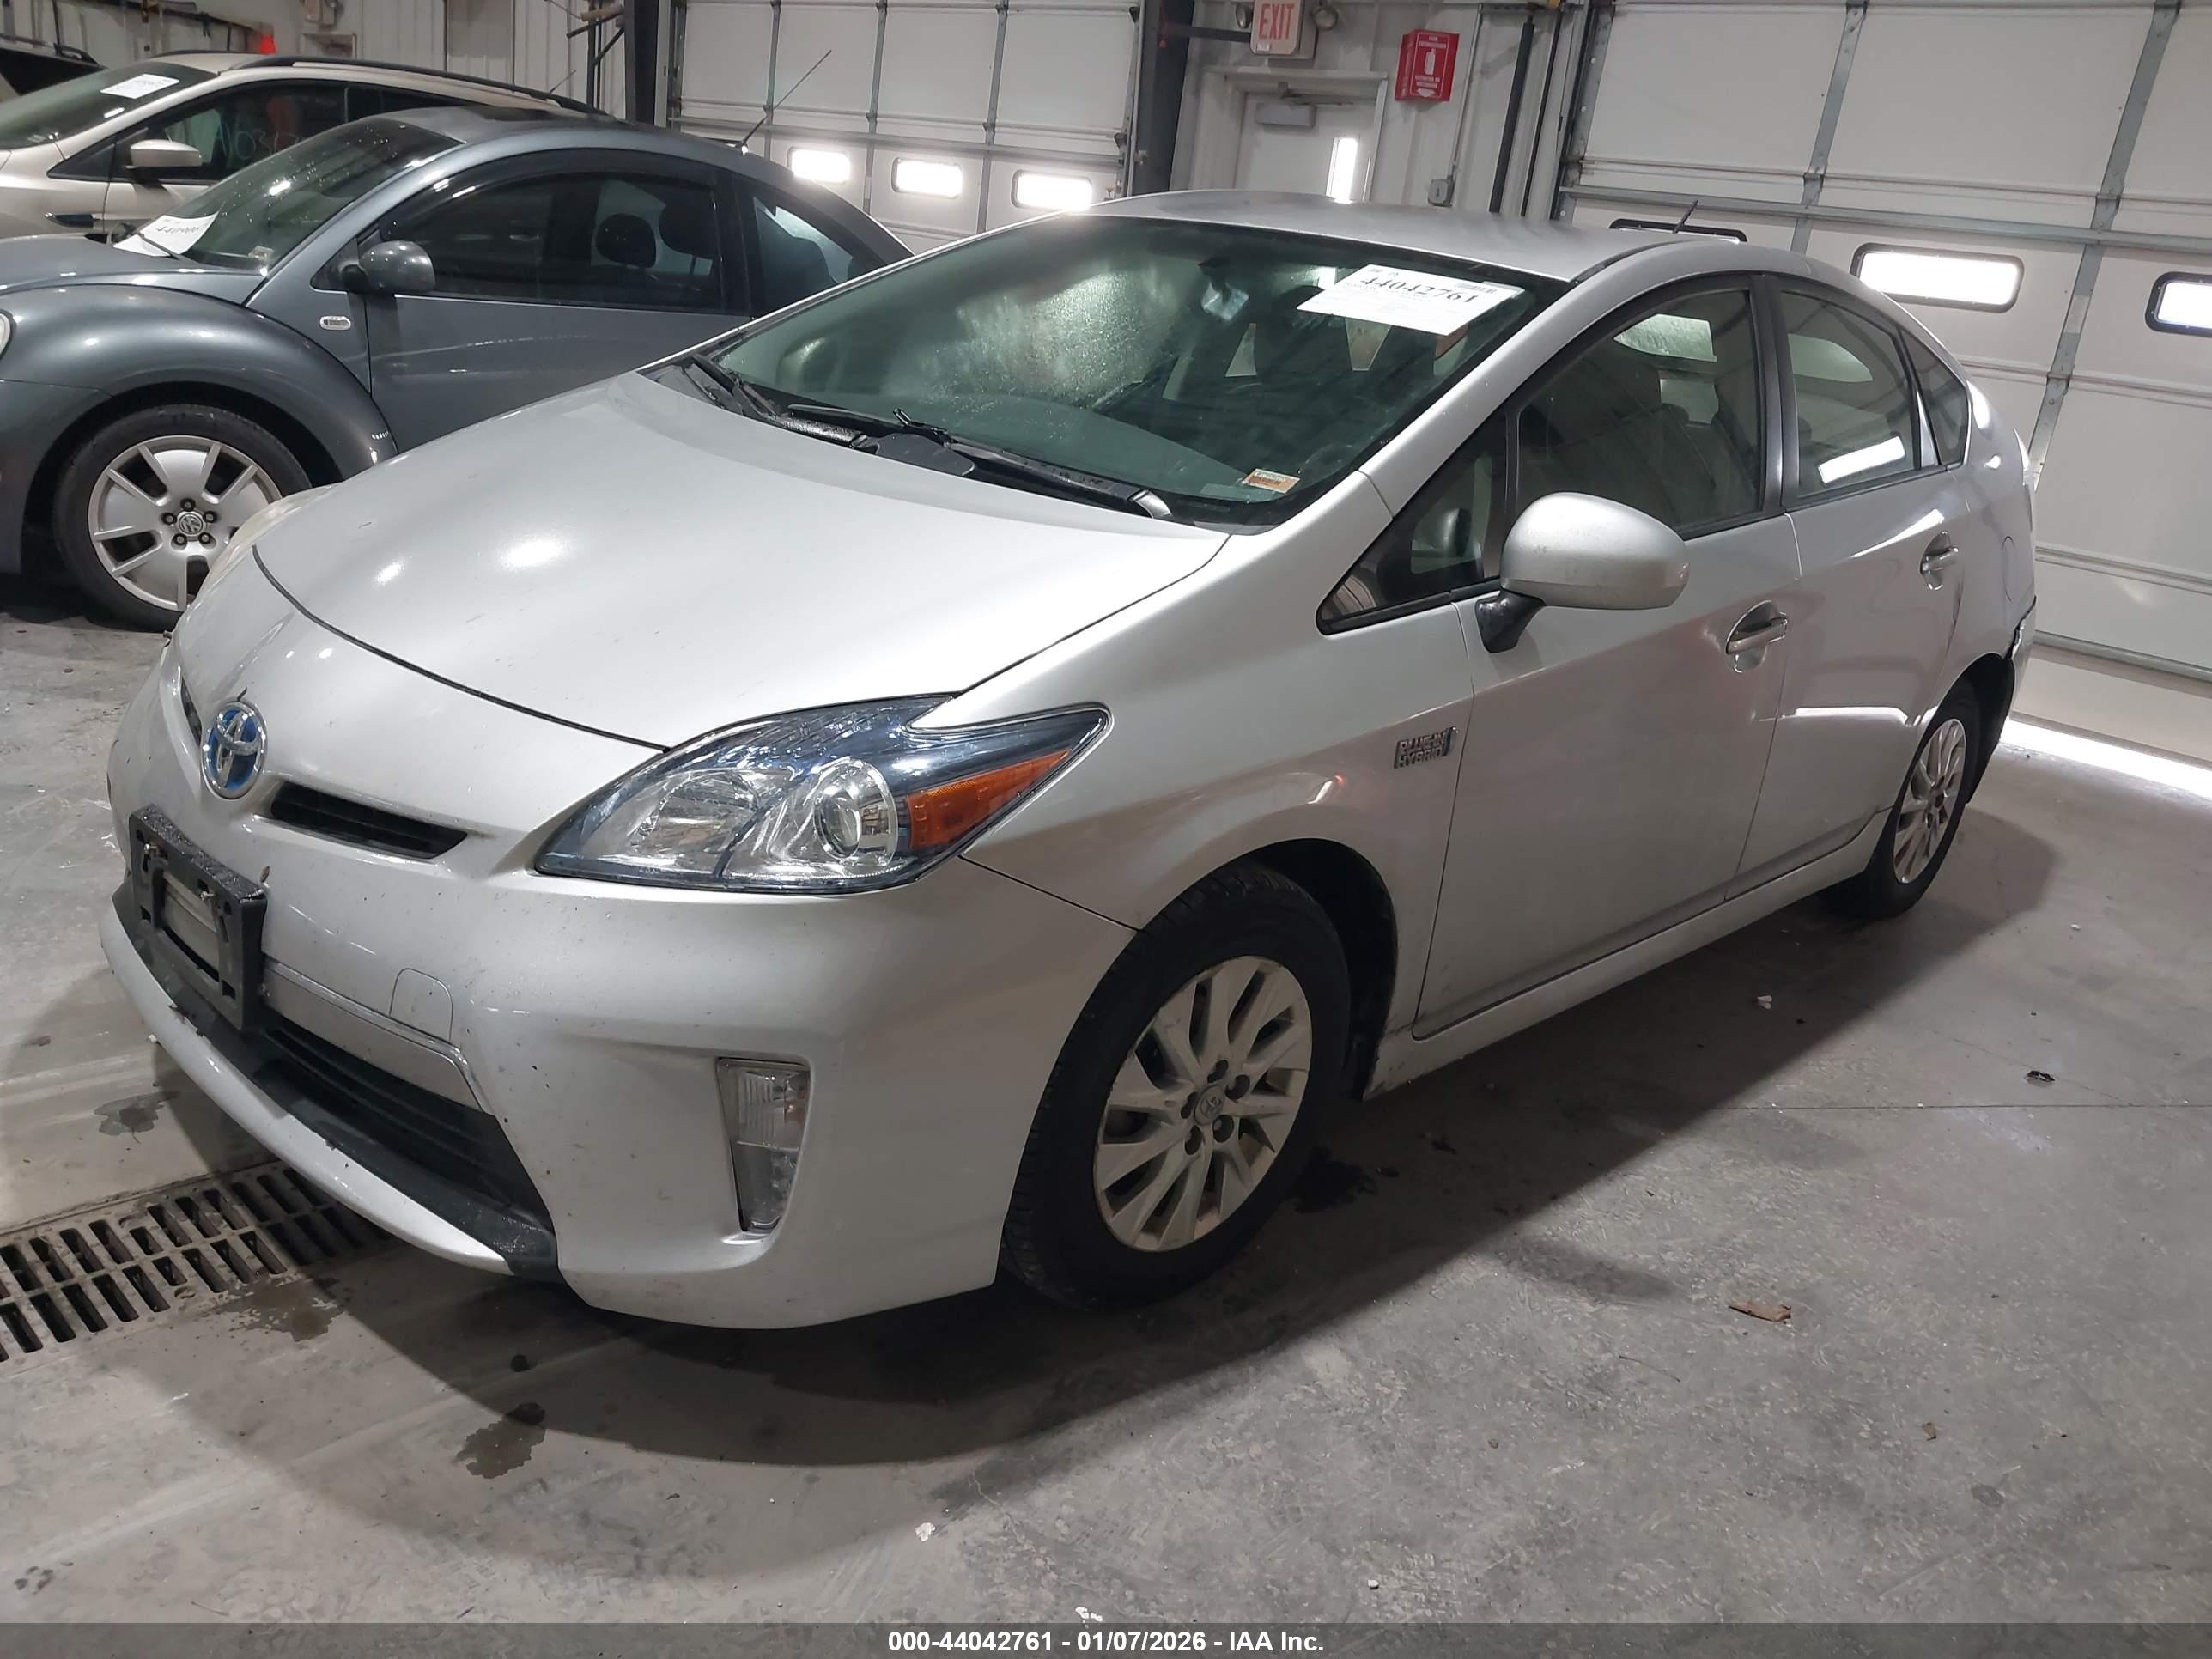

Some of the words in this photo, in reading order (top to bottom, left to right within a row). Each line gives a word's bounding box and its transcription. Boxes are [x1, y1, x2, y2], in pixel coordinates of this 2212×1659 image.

[1258, 3, 1295, 40] EXIT
[1359, 276, 1480, 303] 44042761
[1397, 746, 1443, 768] HYBRID
